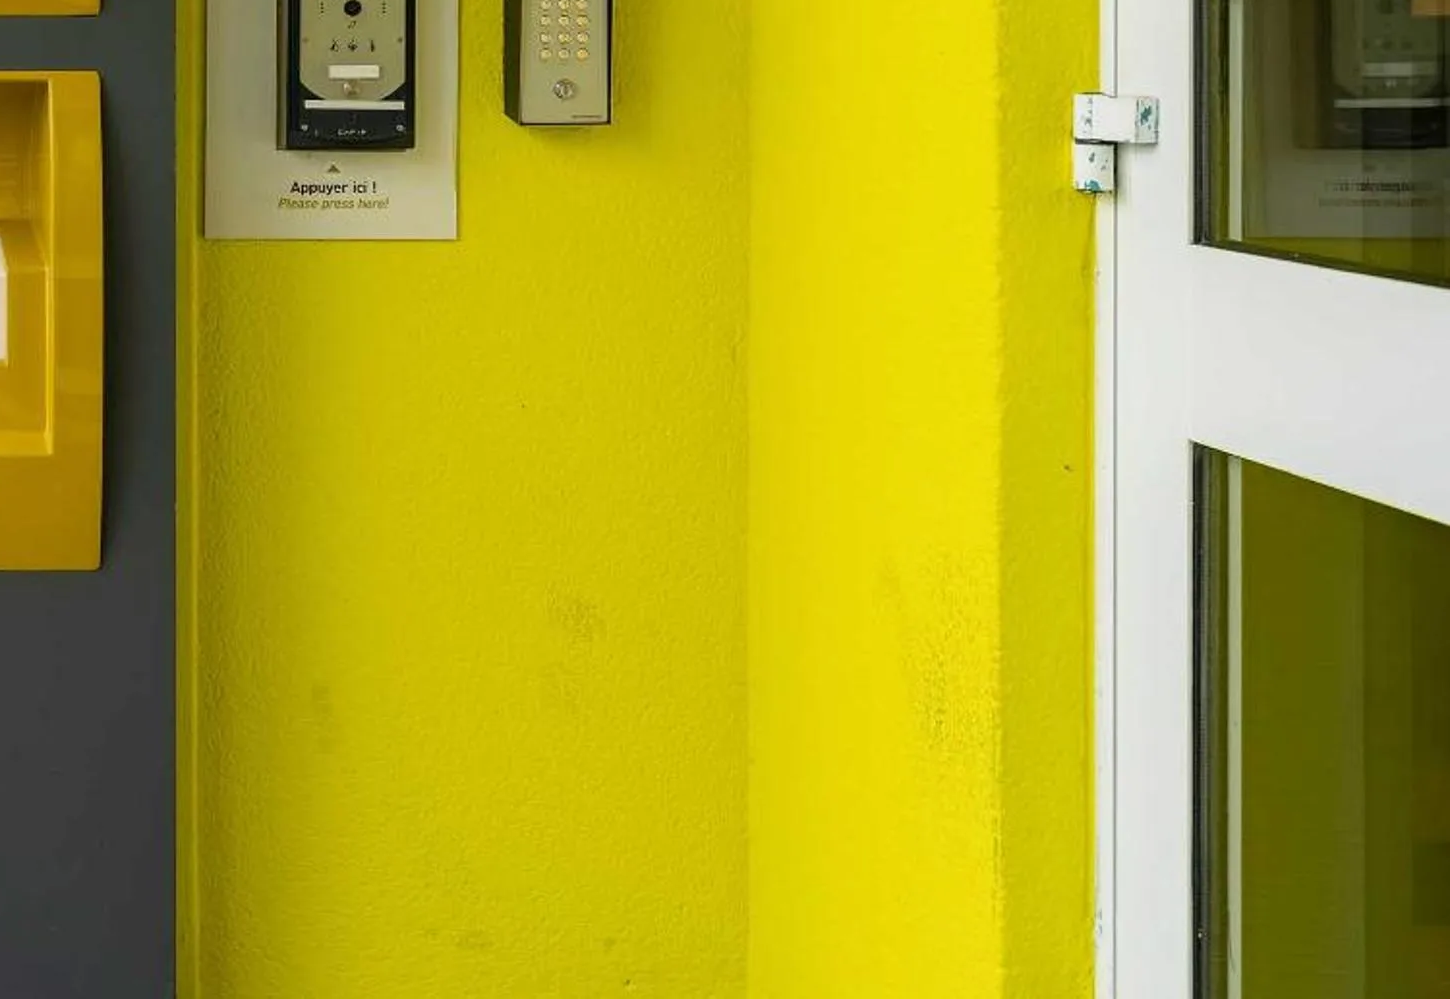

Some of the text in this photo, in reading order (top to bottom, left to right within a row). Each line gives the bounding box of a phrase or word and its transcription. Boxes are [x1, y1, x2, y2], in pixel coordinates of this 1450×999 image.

[290, 180, 377, 195] Appuyer ici !
[278, 198, 390, 211] Please press here!
